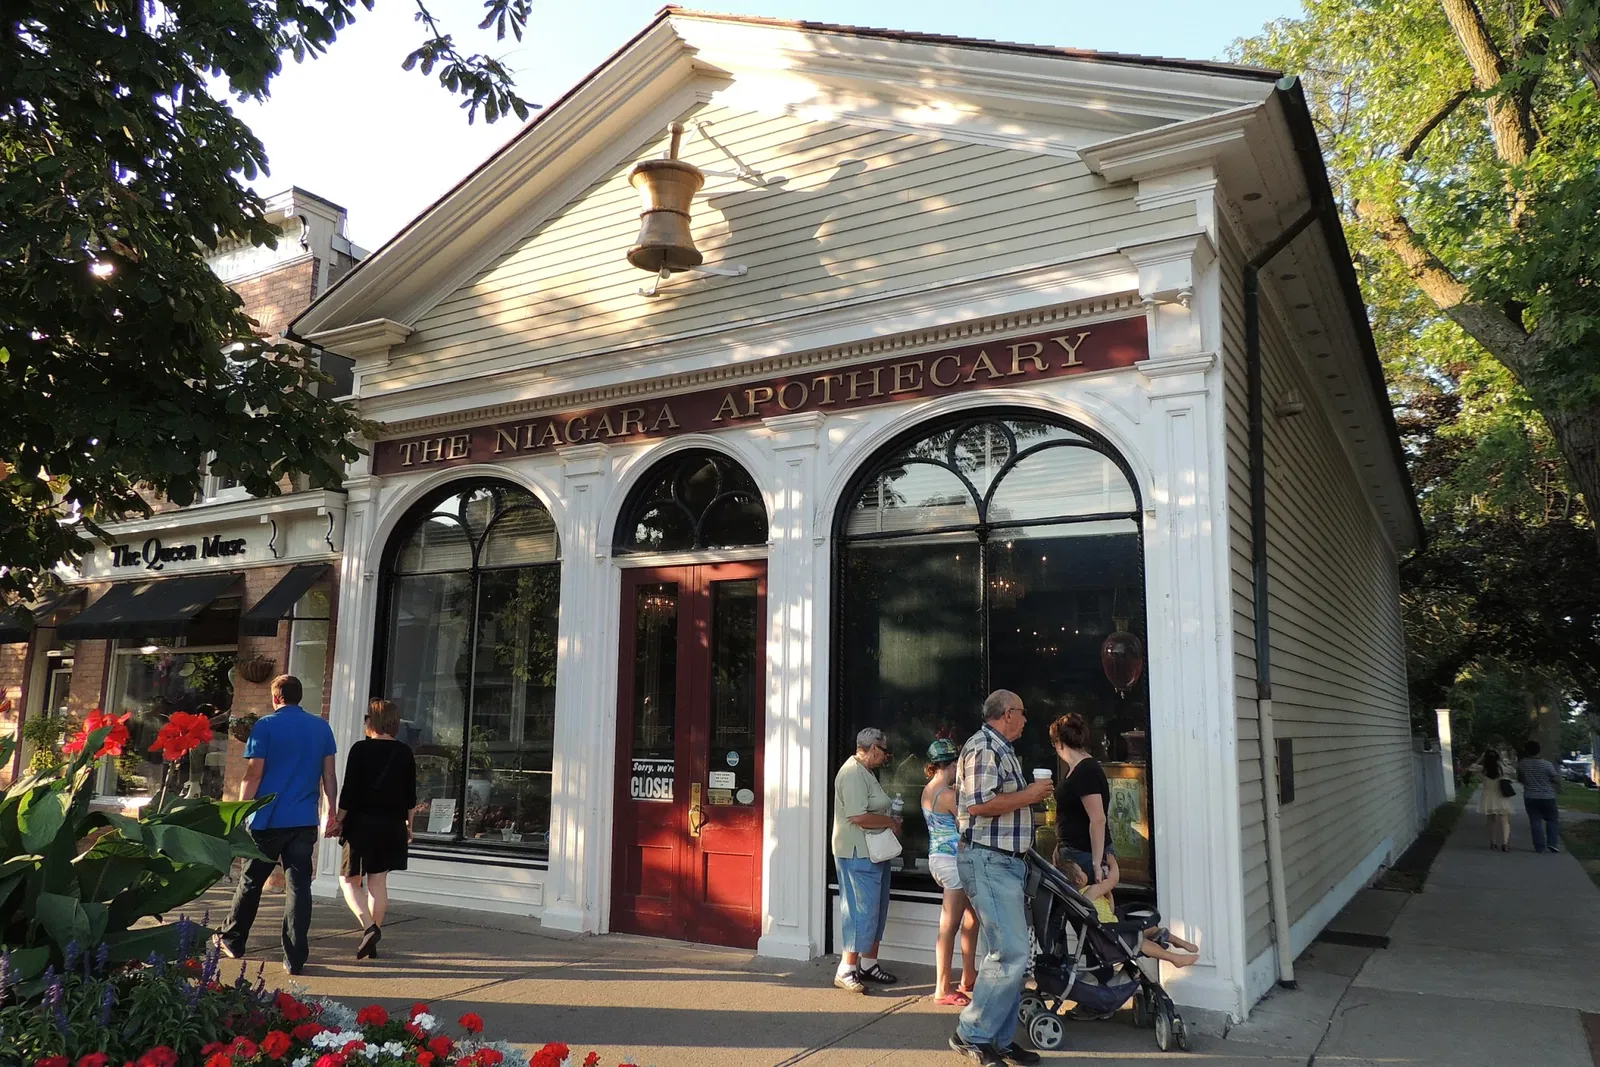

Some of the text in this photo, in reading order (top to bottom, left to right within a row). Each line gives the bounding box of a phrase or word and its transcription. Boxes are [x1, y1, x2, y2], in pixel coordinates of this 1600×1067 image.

[400, 331, 1092, 466] THE NIAGARA APOTHECARY
[111, 534, 246, 570] The Queen Muse
